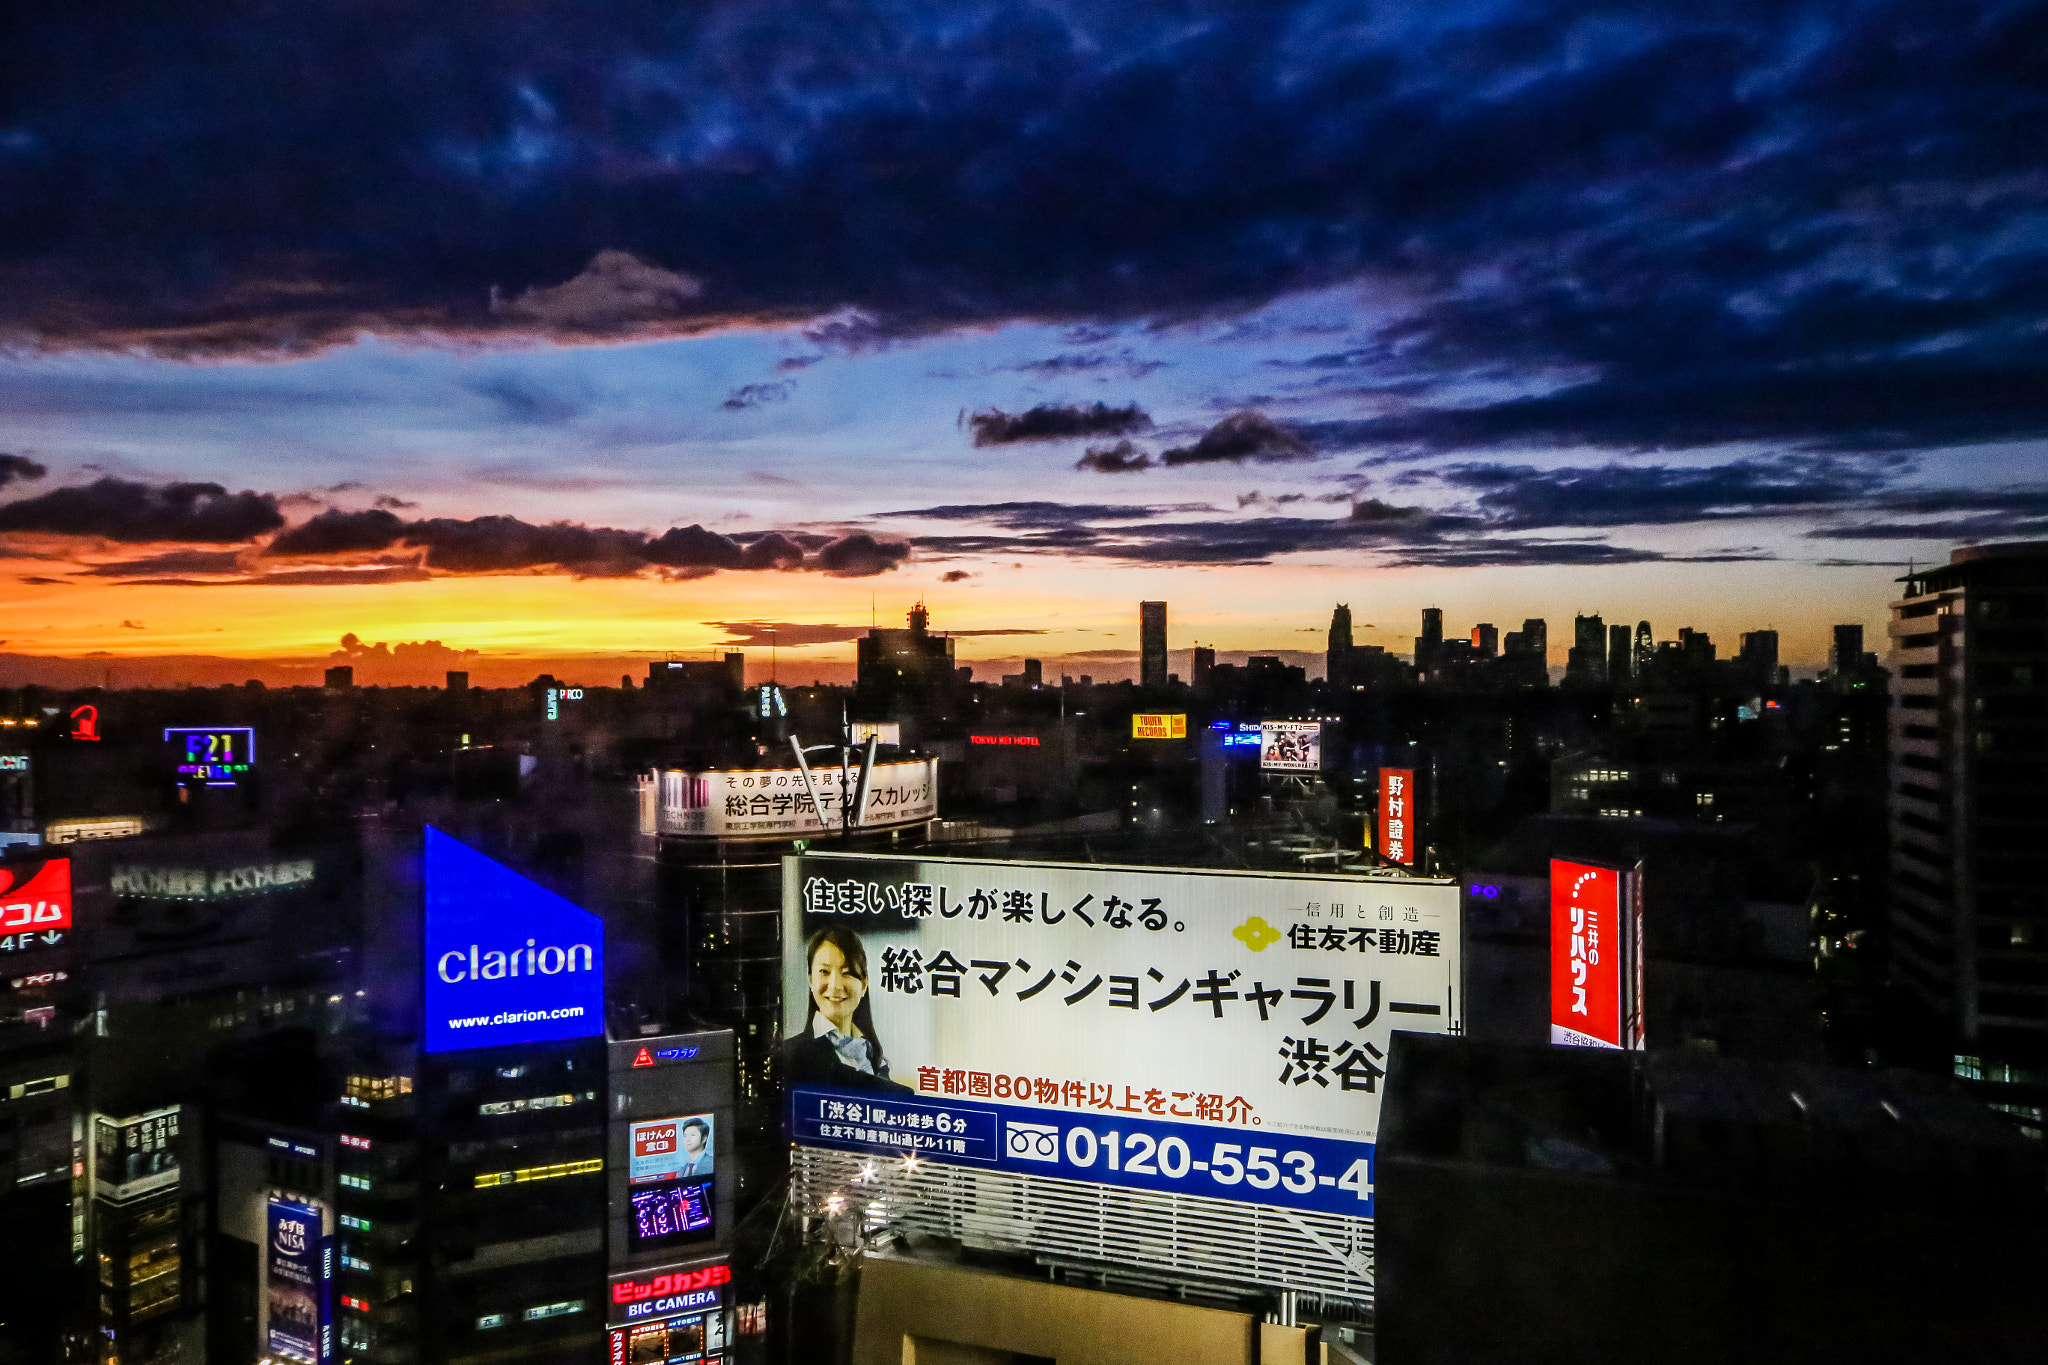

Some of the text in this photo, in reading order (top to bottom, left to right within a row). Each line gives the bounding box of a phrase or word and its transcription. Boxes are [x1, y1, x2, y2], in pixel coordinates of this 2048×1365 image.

[1137, 727, 1167, 737] RECORDS
[1139, 716, 1163, 726] TOWER
[1013, 737, 1040, 746] HOTEL
[1388, 775, 1404, 861] 野村證券
[802, 876, 1186, 934] 住まい探しが楽しくなる。
[1286, 923, 1441, 958] 住友不動産
[1587, 910, 1600, 966] 三井の
[437, 938, 593, 984] clarion
[1570, 906, 1588, 1016] リハウス
[880, 946, 1441, 1030] 総合マンションギャラリー
[448, 1005, 584, 1030] www.clarion.com
[1278, 1035, 1385, 1094] 渋谷
[917, 1065, 1262, 1126] 首都圏80物件以上をご紹介。
[819, 1099, 968, 1134] 「渋谷」駅より徒歩6分
[636, 1128, 675, 1142] ほけんの
[1065, 1126, 1374, 1201] 0120-553-4
[279, 1218, 305, 1236] みずほ
[279, 1231, 305, 1251] NISA
[323, 1247, 332, 1280] MIZUHO
[612, 1265, 731, 1304] ビックカメラ
[628, 1290, 716, 1318] BIC CAMERA
